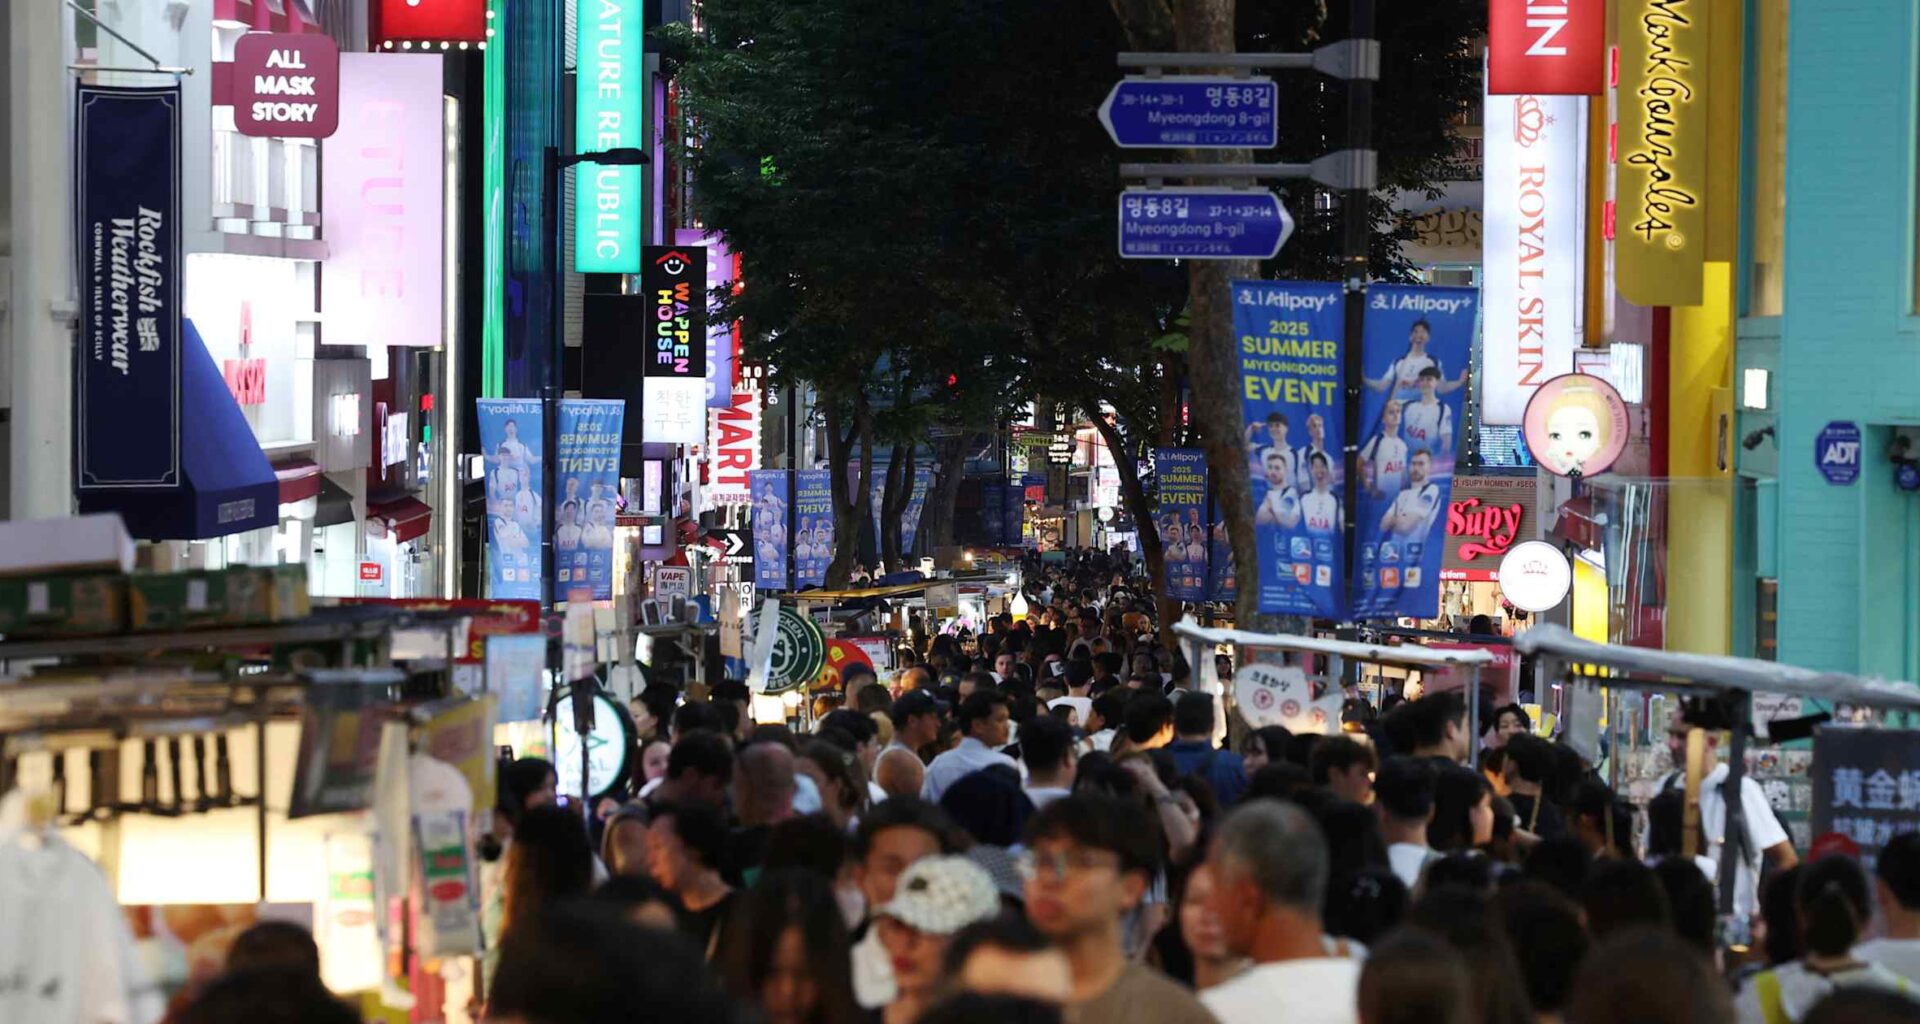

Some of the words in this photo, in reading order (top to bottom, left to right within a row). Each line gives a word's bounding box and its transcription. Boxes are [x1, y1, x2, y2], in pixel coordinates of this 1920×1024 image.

[1524, 0, 1568, 55] IN
[266, 50, 306, 69] ALL
[254, 76, 315, 95] MASK
[1206, 87, 1271, 108] 명동8길
[252, 103, 317, 123] STORY
[1148, 111, 1236, 126] Myeongdong
[1239, 111, 1271, 126] 8-gil
[595, 112, 621, 259] REUBLIC
[1126, 198, 1189, 218] 명동8길
[1126, 222, 1211, 237] Myeongdong
[1214, 222, 1245, 237] 8-gil
[1518, 165, 1546, 290] ROYAL
[94, 222, 103, 272] CORNWALL
[133, 205, 163, 313] Rockfish
[111, 218, 135, 375] Weatherwear
[657, 289, 673, 364] HOUSE
[674, 282, 690, 373] WAPPEN
[1269, 320, 1309, 336] 2025
[1242, 335, 1337, 359] SUMMER
[1518, 297, 1544, 386] SKIN
[1243, 359, 1338, 376] MYEONGDONG
[1244, 375, 1337, 406] EVENT
[718, 394, 753, 489] MART
[1823, 442, 1859, 464] ADT
[1160, 475, 1204, 484] SUMMER
[1484, 480, 1513, 488] MOMENT
[1161, 493, 1204, 504] EVENT
[1446, 497, 1523, 560] Supy
[661, 572, 685, 581] VAPE
